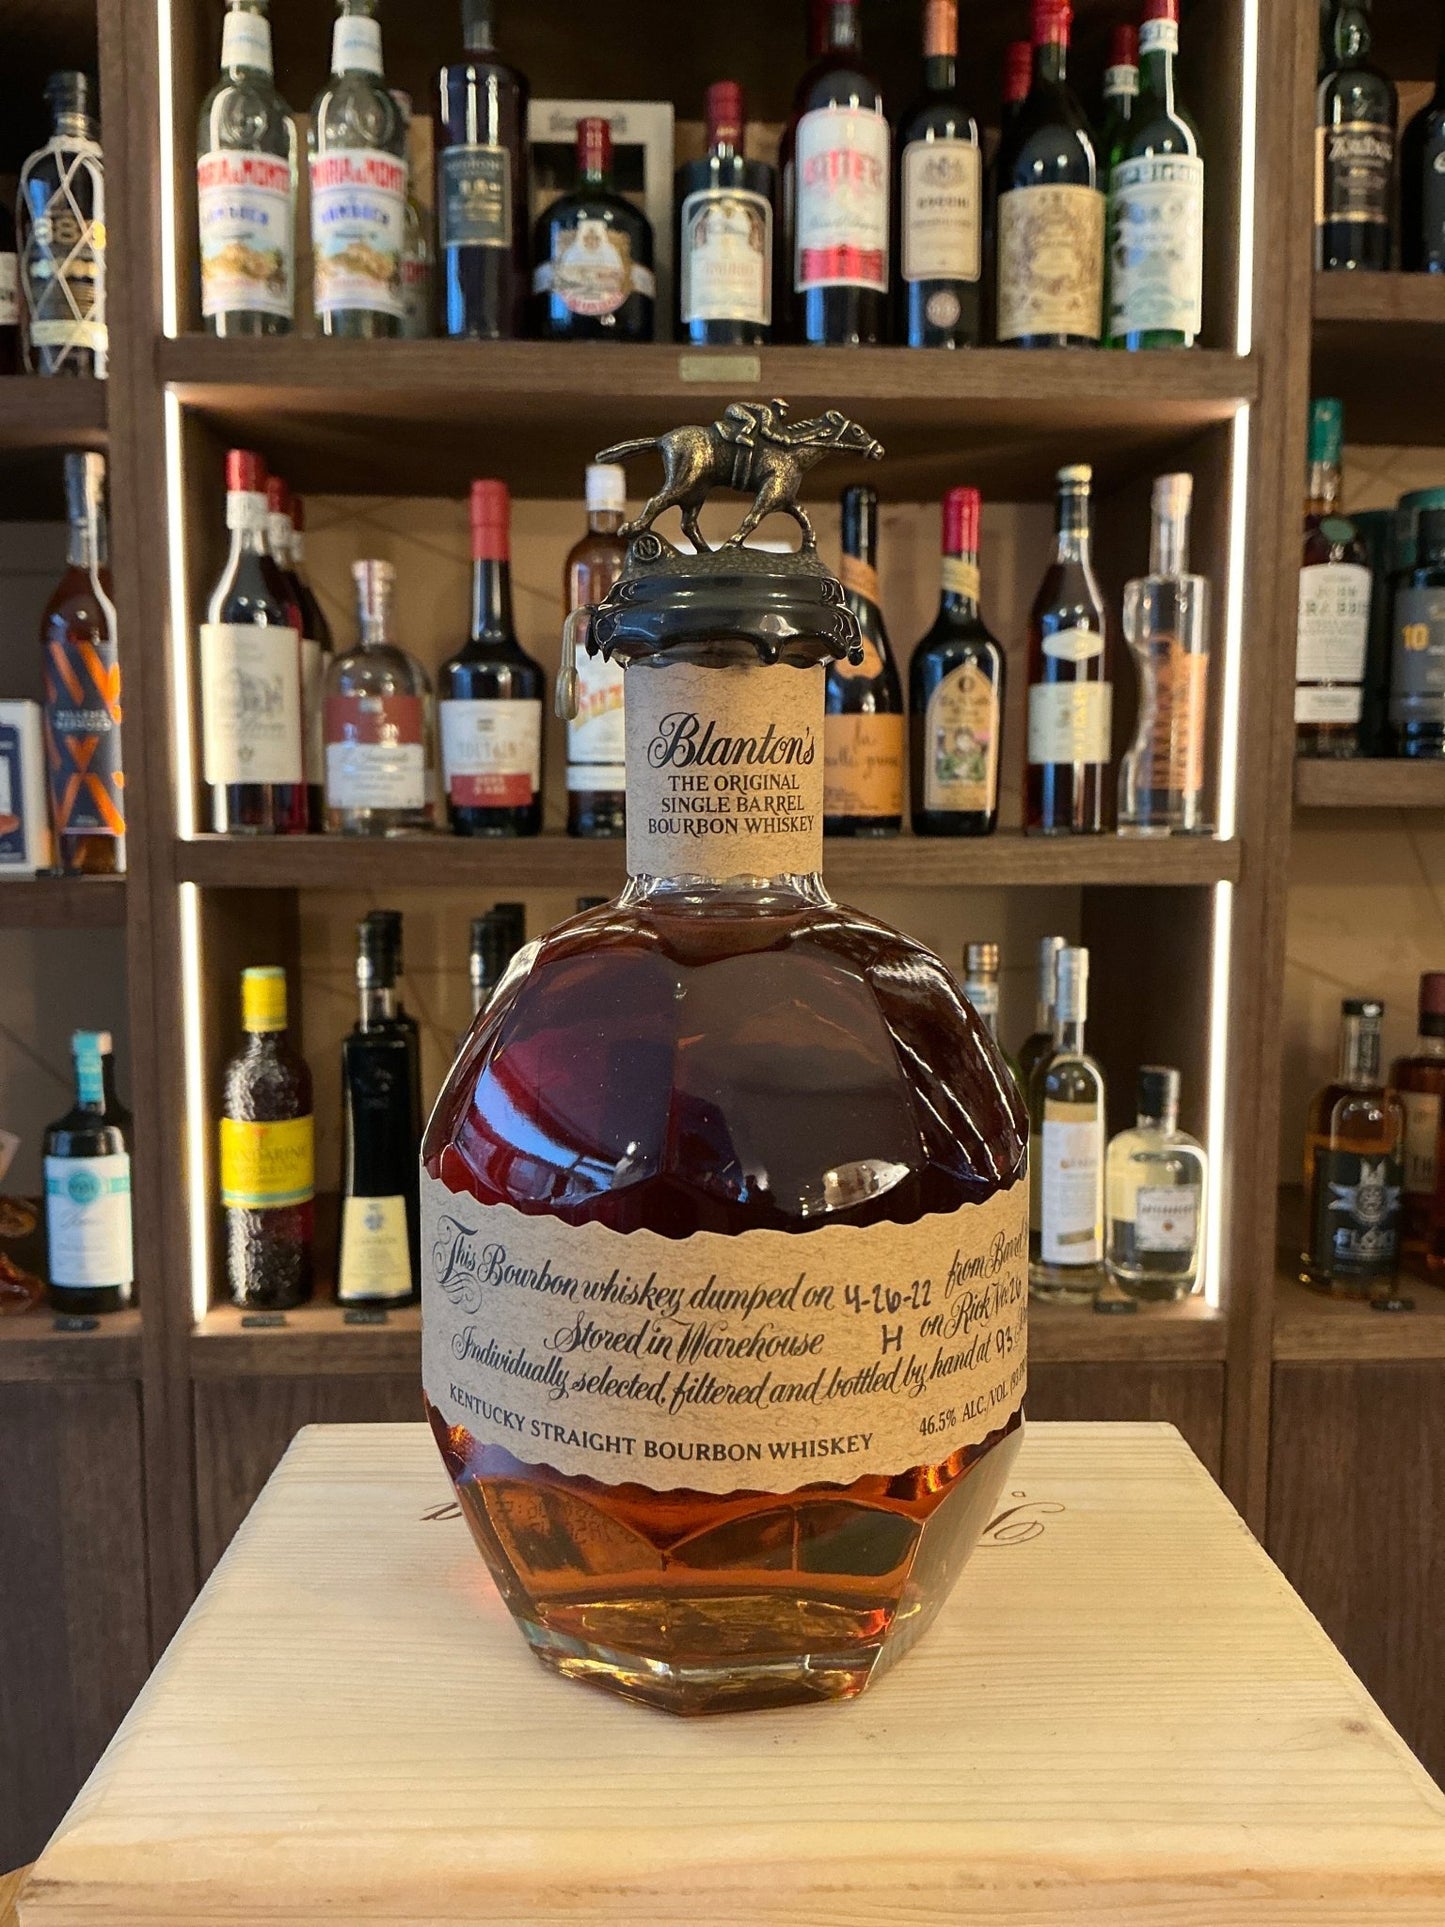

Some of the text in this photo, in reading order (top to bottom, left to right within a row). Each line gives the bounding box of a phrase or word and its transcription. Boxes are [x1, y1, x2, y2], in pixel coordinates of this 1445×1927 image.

[647, 711, 815, 769] Blanton's
[661, 795, 805, 816] SINGLE BARREL
[668, 773, 800, 796] THE ORIGINAL
[648, 815, 815, 838] BOURBON WHISKEY
[432, 1215, 480, 1299] This
[477, 1243, 580, 1303] Bourbon
[581, 1268, 685, 1318] whiskey
[688, 1272, 806, 1321] dumped
[802, 1285, 835, 1312] on
[844, 1279, 932, 1314] 4-26-22
[944, 1249, 985, 1299] from
[543, 1311, 650, 1359] Stored
[648, 1327, 673, 1361] in
[671, 1319, 825, 1365] Warehouse
[881, 1324, 903, 1355] H
[920, 1313, 945, 1338] on
[943, 1286, 991, 1340] Rick
[451, 1325, 569, 1400] Individually
[569, 1365, 671, 1408] selected,
[668, 1371, 772, 1415] filtered
[769, 1367, 827, 1406] and
[825, 1356, 903, 1399] bottled
[902, 1354, 928, 1399] by
[929, 1346, 979, 1380] hand
[975, 1332, 992, 1363] at
[449, 1383, 526, 1432] KENTUCKY
[530, 1419, 637, 1455] STRAIGHT
[643, 1439, 762, 1461] BOURBON
[767, 1432, 874, 1460] WHISKEY
[919, 1408, 957, 1436] 46.5%
